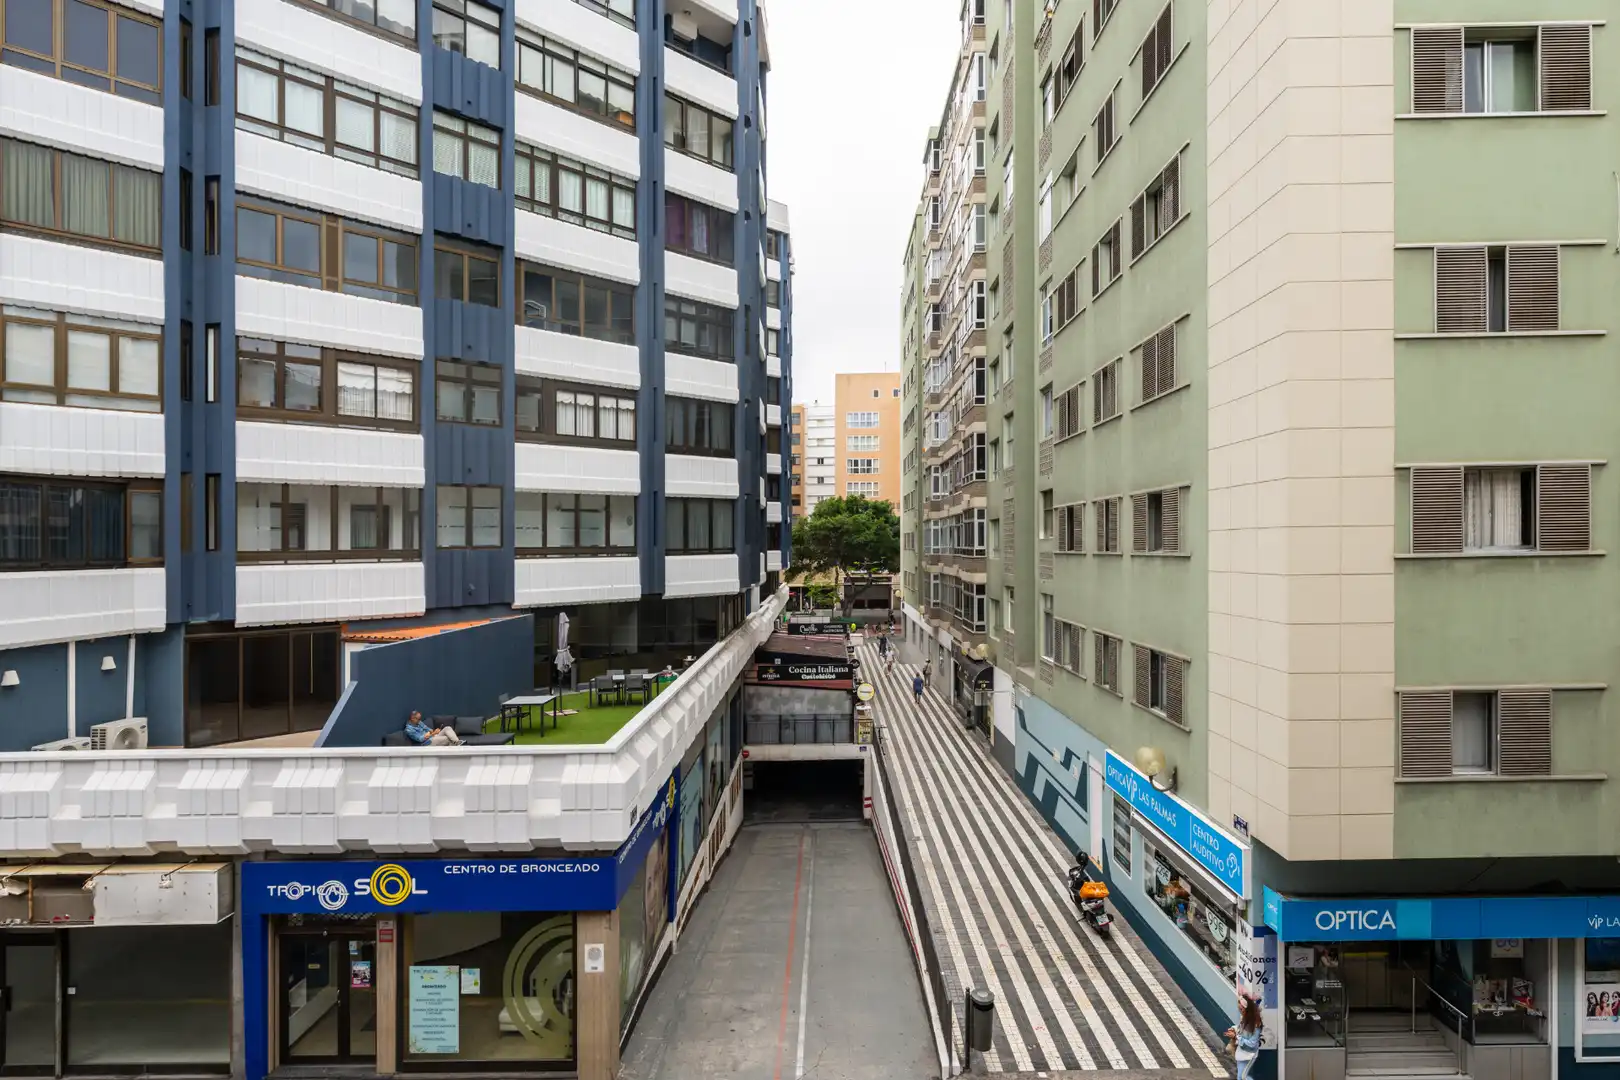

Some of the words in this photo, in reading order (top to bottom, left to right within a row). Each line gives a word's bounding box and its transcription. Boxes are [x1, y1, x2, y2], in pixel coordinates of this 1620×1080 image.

[788, 665, 817, 674] Cocina
[818, 665, 849, 674] Italiana
[1138, 788, 1150, 808] LAS
[1150, 797, 1177, 828] PALMAS
[1192, 823, 1220, 851] CENTRO
[443, 864, 496, 875] CENTRO
[499, 864, 518, 875] DE
[520, 862, 601, 874] BRONCEADO
[1192, 840, 1225, 872] AUDITIVO
[266, 880, 350, 911] TROPICAL
[353, 863, 429, 906] SOL
[1314, 909, 1397, 931] OPTICA
